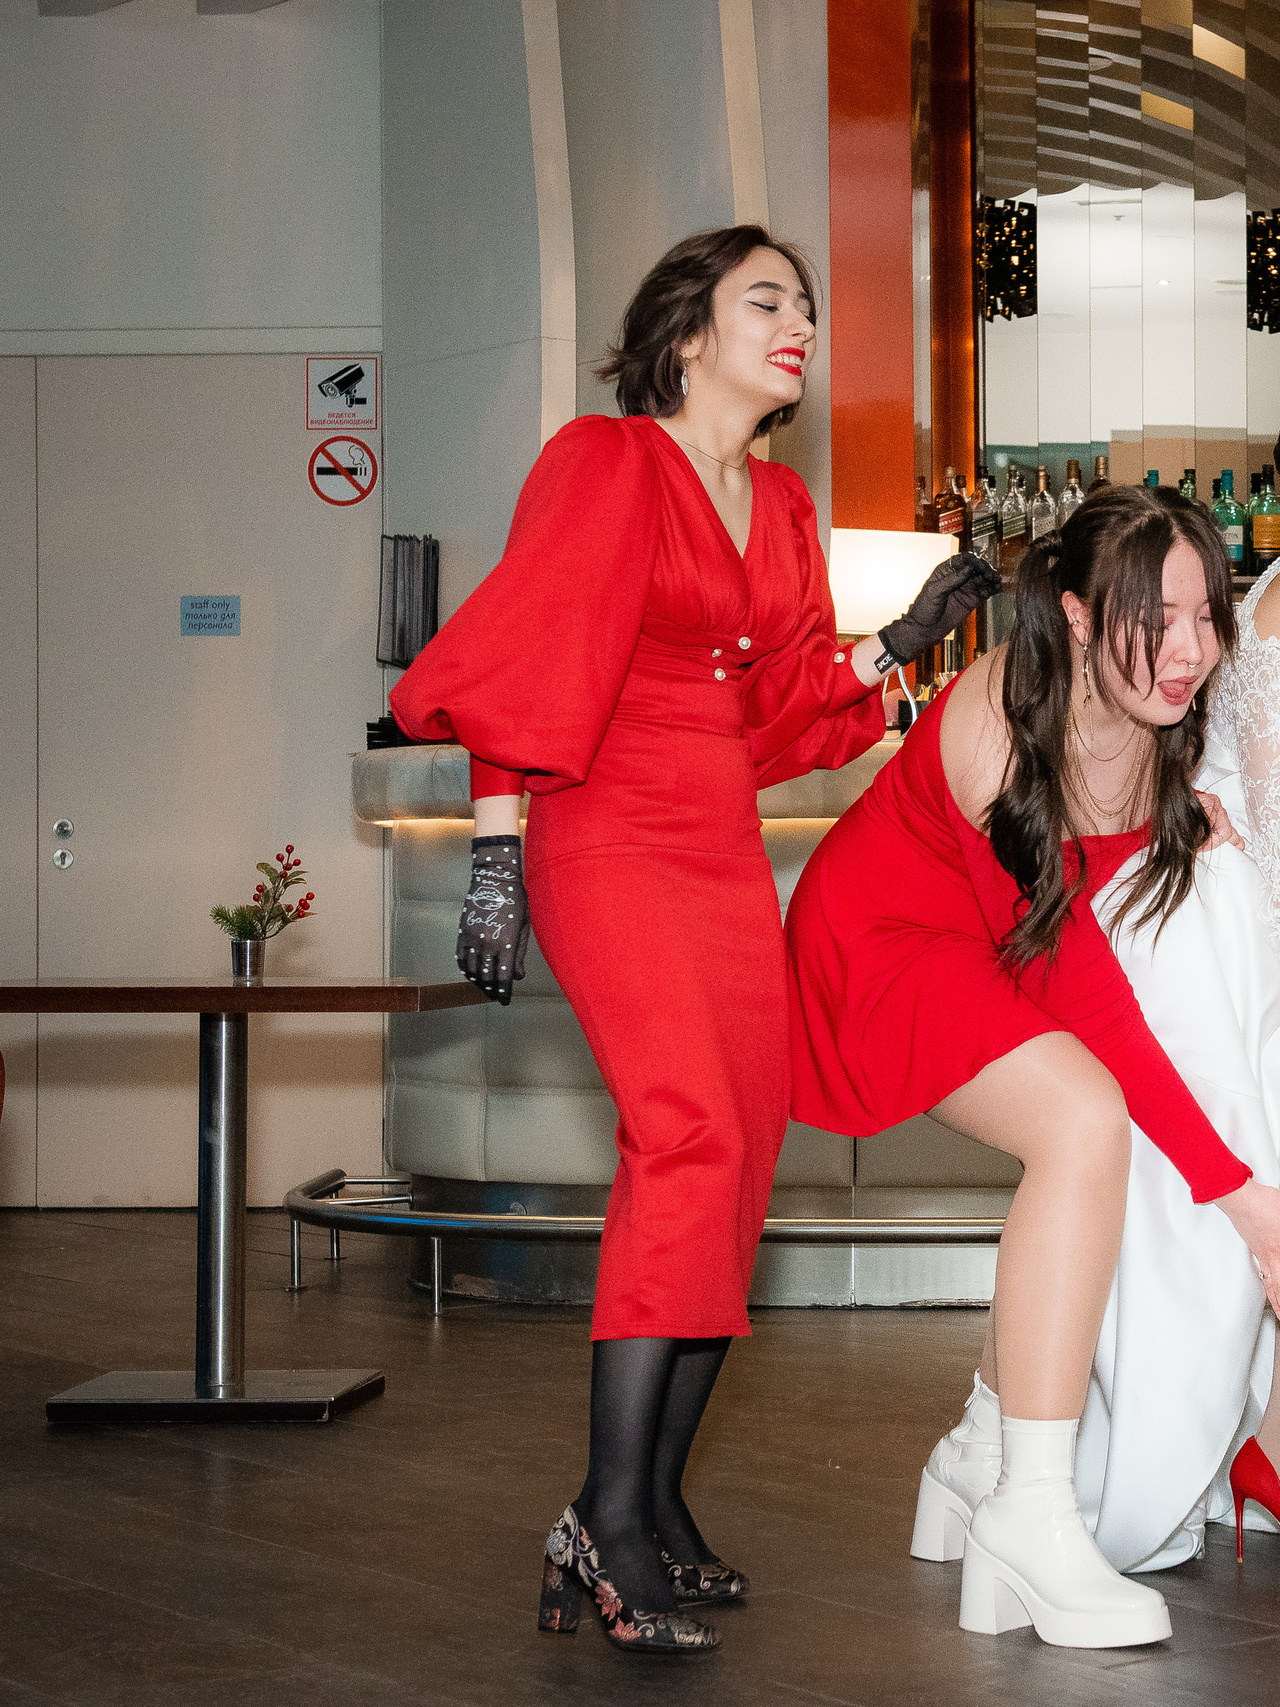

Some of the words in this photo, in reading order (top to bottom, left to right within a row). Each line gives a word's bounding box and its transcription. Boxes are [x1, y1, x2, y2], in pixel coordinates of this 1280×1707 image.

[190, 599, 209, 609] staff
[212, 599, 230, 611] only
[185, 612, 218, 620] только
[220, 612, 236, 622] для
[188, 622, 233, 632] персонала
[466, 911, 506, 939] baby
